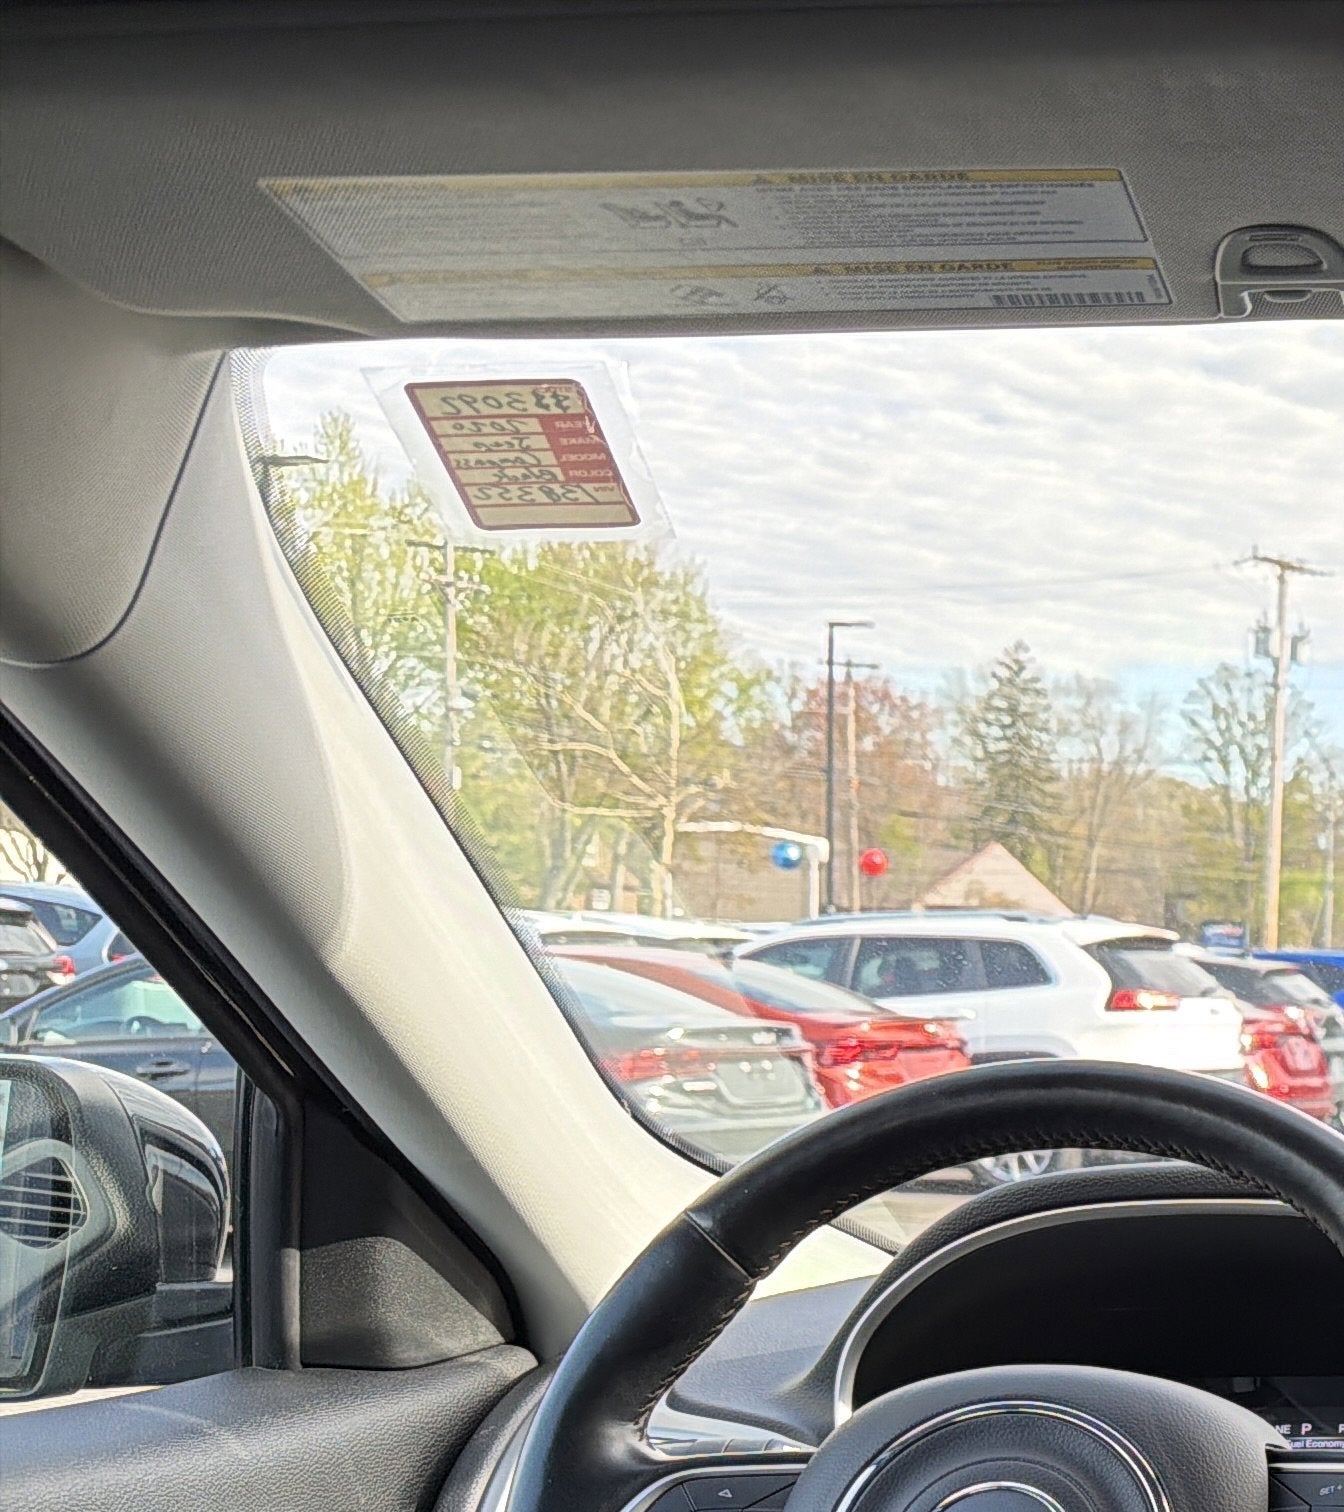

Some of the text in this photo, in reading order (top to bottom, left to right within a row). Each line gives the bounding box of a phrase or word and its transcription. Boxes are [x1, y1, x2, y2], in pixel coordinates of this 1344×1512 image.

[890, 171, 969, 182] GARDE
[939, 261, 1015, 272] GARDE
[1301, 1423, 1312, 1435] P
